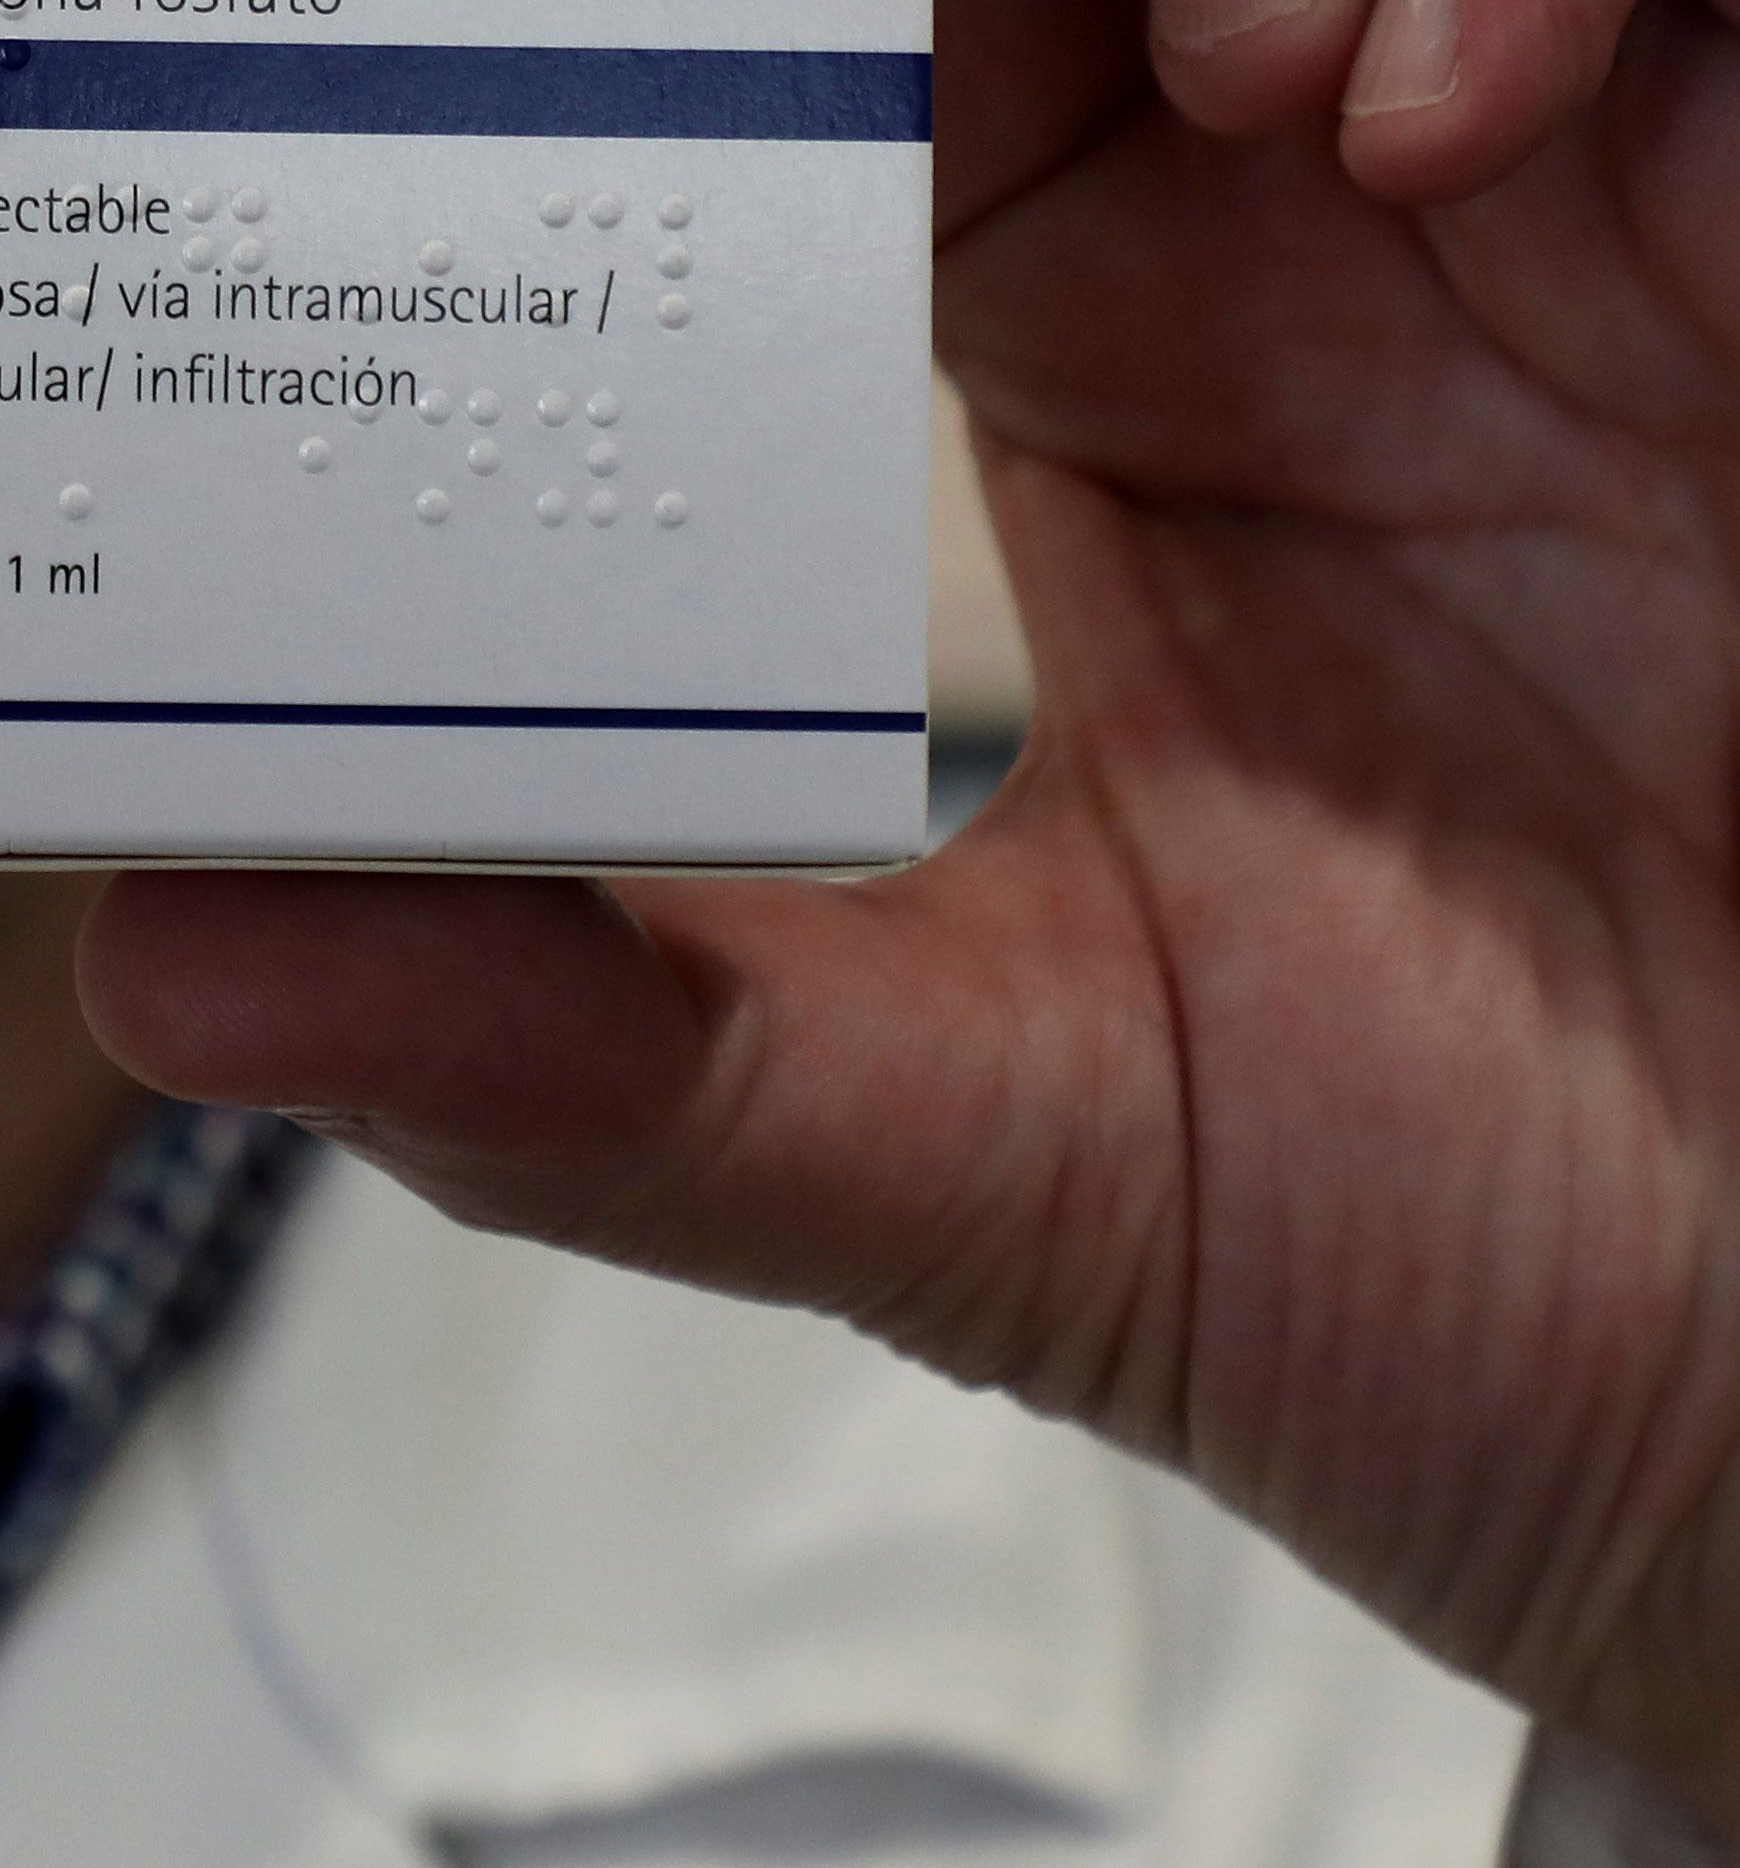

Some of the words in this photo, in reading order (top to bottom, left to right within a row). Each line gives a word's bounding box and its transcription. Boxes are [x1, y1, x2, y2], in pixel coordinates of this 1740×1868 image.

[82, 262, 99, 327] /
[118, 269, 189, 319] vía
[215, 273, 578, 325] intramuscular
[597, 269, 615, 334] /
[136, 352, 416, 406] infiltración
[9, 555, 22, 593] 1
[49, 552, 99, 594] ml
